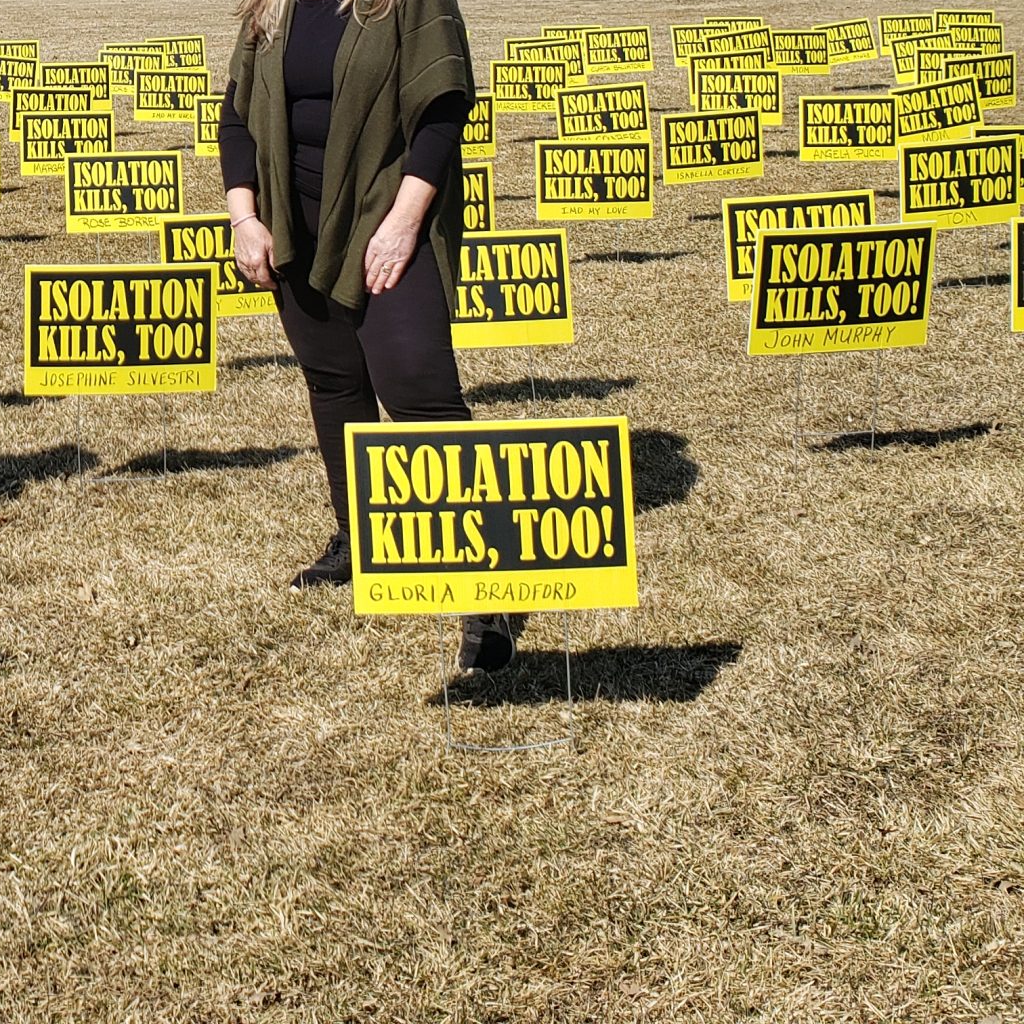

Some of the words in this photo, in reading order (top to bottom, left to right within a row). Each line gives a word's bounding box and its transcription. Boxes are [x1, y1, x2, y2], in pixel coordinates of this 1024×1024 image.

[882, 18, 931, 33] ISOLATION
[588, 31, 646, 49] ISOLATION
[774, 35, 826, 50] ISOLATION
[849, 37, 872, 51] TOO!
[180, 54, 202, 66] TOO!
[589, 49, 621, 63] KILLS,
[622, 47, 648, 61] TOO!
[776, 51, 803, 64] KILLS,
[806, 51, 827, 63] TOO!
[45, 67, 106, 84] ISOLATION
[140, 75, 205, 92] ISOLATION
[496, 66, 563, 83] ISOLATION
[701, 75, 776, 93] ISOLATION
[496, 84, 532, 100] KILLS,
[985, 78, 1012, 96] TOO!
[16, 93, 88, 112] ISOLATION
[139, 92, 174, 109] KILLS,
[562, 89, 642, 115] ISOLATION
[745, 94, 776, 110] TOO!
[897, 82, 974, 115] ISOLATION
[563, 114, 607, 134] KILLS,
[610, 111, 644, 130] TOO!
[806, 103, 892, 125] ISOLATION
[899, 111, 943, 134] KILLS,
[944, 103, 977, 125] TOO!
[27, 117, 108, 139] ISOLATION
[669, 116, 756, 144] ISOLATION
[806, 125, 853, 146] KILLS,
[857, 125, 892, 144] TOO!
[544, 149, 646, 175] ISOLATION
[669, 144, 717, 166] KILLS,
[720, 140, 756, 161] TOO!
[813, 149, 850, 159] ANGELA
[909, 145, 1013, 181] ISOLATION
[73, 160, 174, 187] ISOLATION
[677, 169, 713, 180] ISABELLA
[717, 167, 750, 176] CORTESE
[544, 177, 599, 201] KILLS,
[605, 176, 645, 198] TOO!
[909, 180, 965, 209] KILLS,
[970, 175, 1013, 203] TOO!
[74, 189, 127, 213] KILLS,
[133, 188, 175, 211] TOO!
[588, 207, 601, 216] MY
[606, 207, 628, 215] LOVE
[938, 211, 978, 225] TOM
[78, 218, 111, 228] ROSE
[768, 238, 925, 284] ISOLATION
[38, 278, 204, 322] ISOLATION
[500, 282, 560, 316] TOO!
[764, 288, 846, 324] KILLS,
[858, 280, 920, 317] TOO!
[38, 324, 125, 366] KILLS,
[135, 322, 204, 360] TOO!
[764, 331, 813, 349] JOHN
[823, 326, 896, 347] MURPHY
[40, 371, 116, 387] JOSEPHINE
[126, 370, 201, 386] SILVESTRI
[366, 440, 610, 504] ISOLATION
[369, 510, 499, 569] KILLS,
[512, 505, 614, 561] TOO!
[370, 583, 454, 603] GLORIA
[474, 582, 577, 601] BRADFORD
